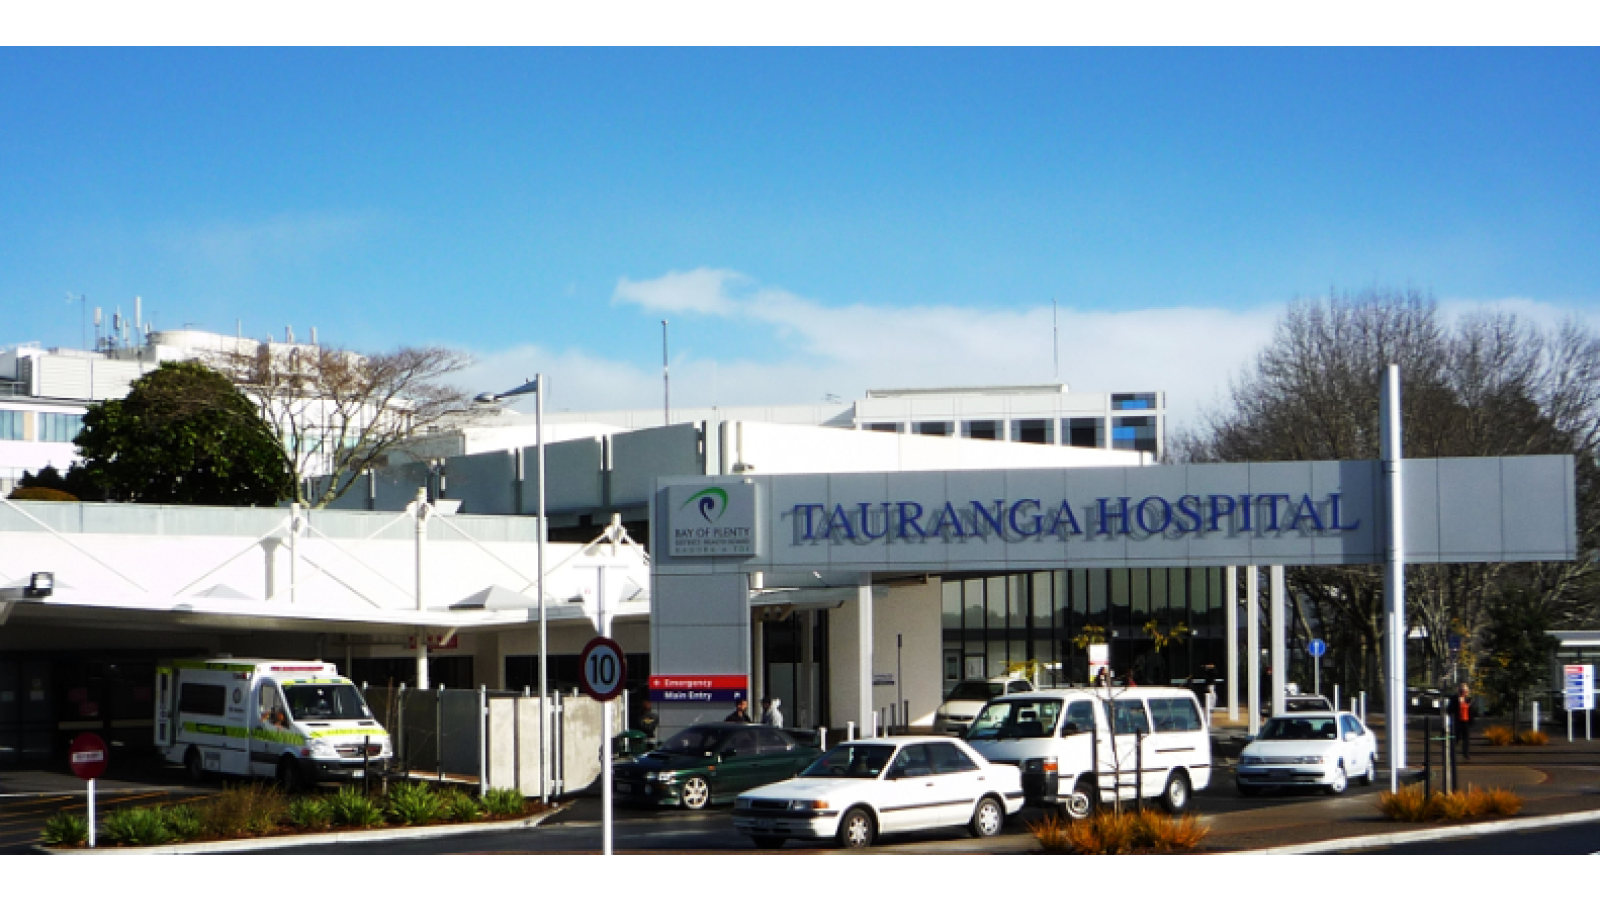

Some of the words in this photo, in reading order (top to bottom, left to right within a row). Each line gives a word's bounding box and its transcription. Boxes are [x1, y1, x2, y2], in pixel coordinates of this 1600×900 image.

[794, 499, 1082, 539] TAURANGA
[1095, 492, 1361, 534] HOSPITAL
[675, 528, 694, 538] BAY
[696, 527, 710, 538] OF
[713, 527, 751, 537] PLENTY
[590, 654, 616, 685] 10
[664, 679, 713, 689] Emergency
[664, 691, 687, 700] Main
[689, 691, 713, 701] Entry
